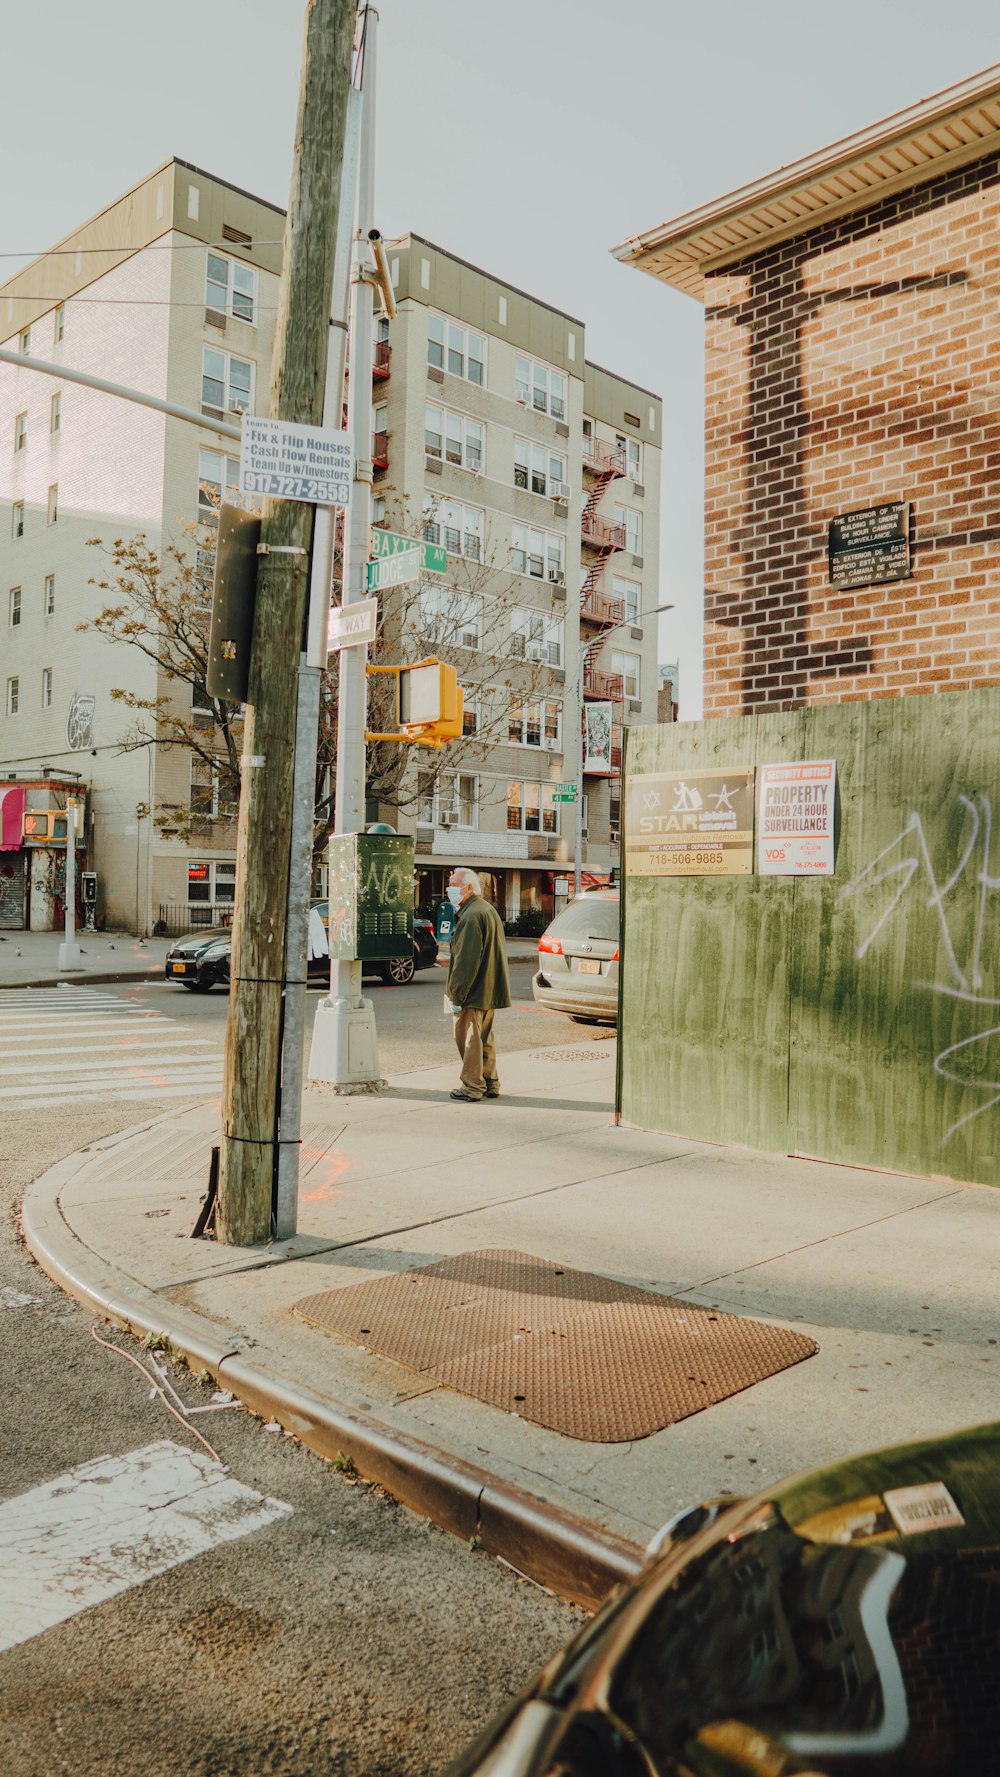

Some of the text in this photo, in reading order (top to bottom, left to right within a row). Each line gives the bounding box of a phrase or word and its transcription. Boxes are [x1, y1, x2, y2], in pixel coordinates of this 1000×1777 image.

[246, 419, 269, 429] Learn
[251, 430, 351, 455] Fix & Flip Houses
[250, 444, 351, 469] Cash Flow Rentals
[250, 457, 350, 482] Team Up w/Investors
[245, 472, 349, 503] 917-727-2558
[833, 518, 845, 526] THE
[847, 510, 876, 522] EXTERIOR
[879, 507, 889, 515] OF
[840, 521, 866, 533] BUILDING
[878, 513, 899, 524] UNDER
[841, 522, 898, 540] 24 HOUR CAMERA
[433, 549, 445, 561] AV
[832, 556, 840, 565] EL
[843, 550, 872, 562] EXTERIOR
[874, 548, 883, 556] DE
[832, 562, 856, 572] EDIFICIO
[878, 552, 906, 563] VIGILADO
[368, 559, 403, 588] JUDGE
[832, 571, 846, 580] POR
[888, 560, 906, 569] VIDEO
[840, 578, 848, 586] 24
[851, 574, 872, 584] HORAS
[345, 614, 367, 633] WAY
[767, 766, 830, 780] SECURITY NOTICE
[766, 784, 828, 805] PROPERTY
[765, 803, 828, 818] UNDER 24 HOUR
[639, 813, 698, 833] STAR
[764, 817, 828, 832] SURVEILLANCE
[712, 832, 746, 841] Removal
[649, 852, 723, 864] 718-506-9885
[765, 849, 786, 859] VDS
